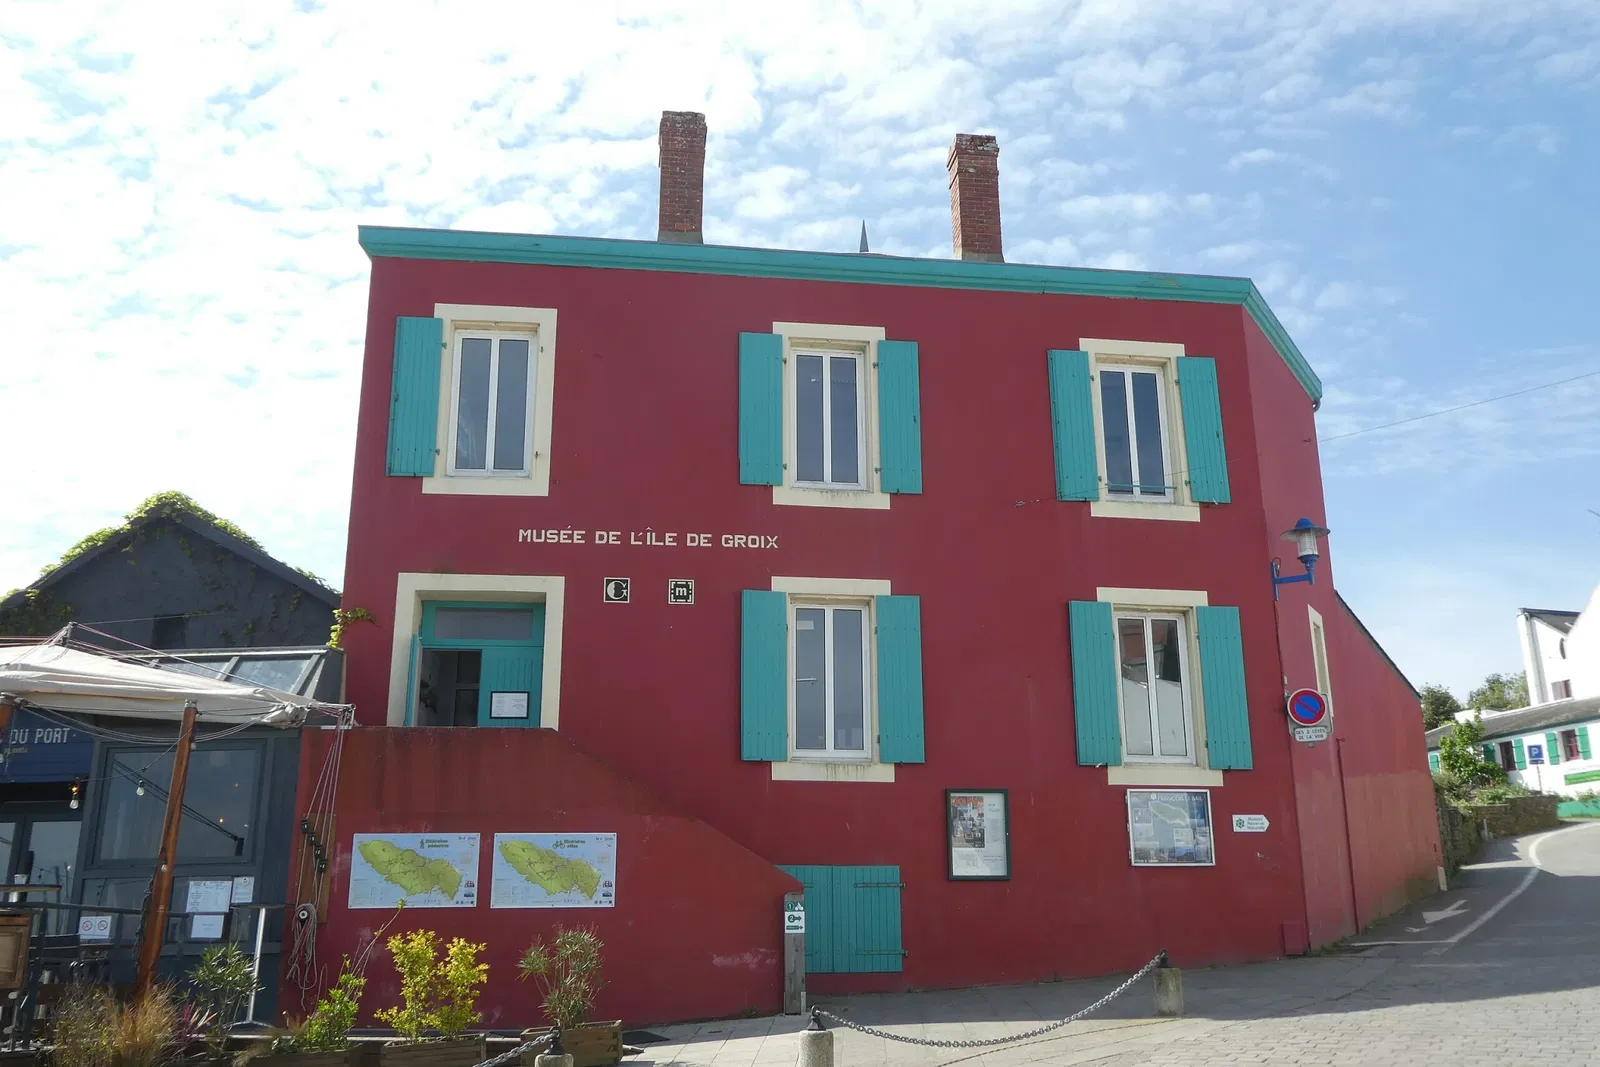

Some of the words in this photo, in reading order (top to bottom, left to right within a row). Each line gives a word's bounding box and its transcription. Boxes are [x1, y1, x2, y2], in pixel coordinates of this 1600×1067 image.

[518, 525, 586, 544] MUSÉE
[595, 530, 621, 545] DE
[630, 526, 678, 546] L'ÎLE
[686, 533, 712, 547] DE
[721, 534, 779, 549] GROIX
[34, 727, 71, 744] PORT
[1531, 747, 1539, 757] P
